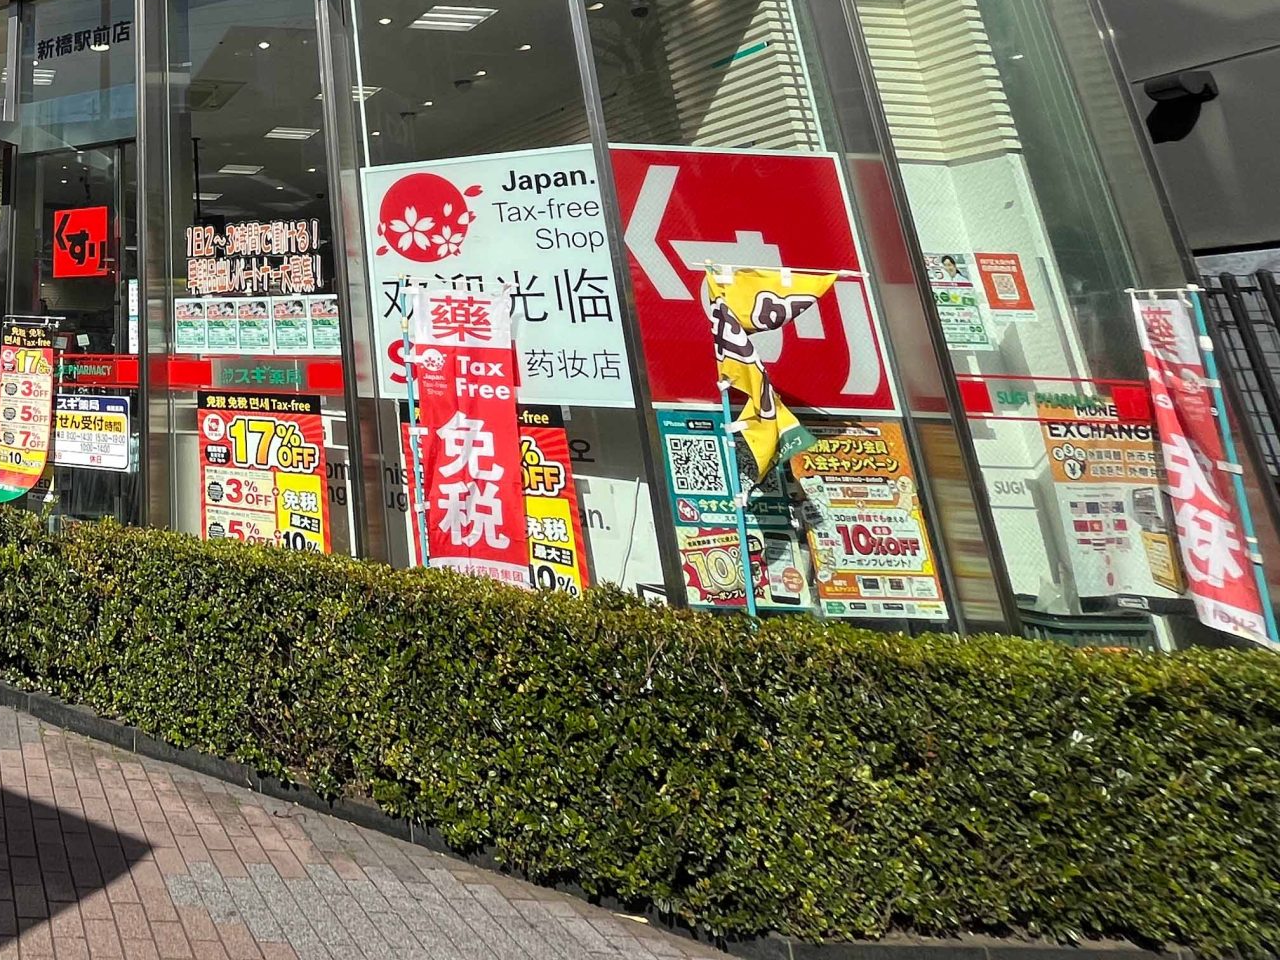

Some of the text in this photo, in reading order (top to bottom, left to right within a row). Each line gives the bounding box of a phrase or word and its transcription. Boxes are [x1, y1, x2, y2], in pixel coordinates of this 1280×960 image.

[37, 20, 134, 61] 新橋駅前店
[502, 169, 596, 195] Japan.
[491, 199, 600, 223] Tax-free
[55, 214, 106, 269] くすり
[536, 228, 605, 253] Shop
[382, 268, 614, 324] 欢光临
[429, 295, 493, 342] 藥
[235, 365, 302, 385] スギ薬局
[456, 355, 505, 377] Tax
[524, 348, 622, 380] 药妆店
[456, 378, 511, 400] Free
[57, 397, 100, 411] スギ薬局
[249, 397, 270, 411] 면세
[270, 398, 311, 411] Tax-free
[1077, 404, 1118, 417] MONE
[519, 410, 550, 425] -free
[229, 418, 302, 465] 17%
[1048, 422, 1154, 439] EXCHANG
[277, 445, 316, 469] OFF
[803, 455, 899, 473] 入会キャンペーン
[436, 410, 510, 549] 免税
[994, 480, 1026, 496] SUGI
[245, 494, 272, 507] OFF
[282, 489, 319, 513] 免税
